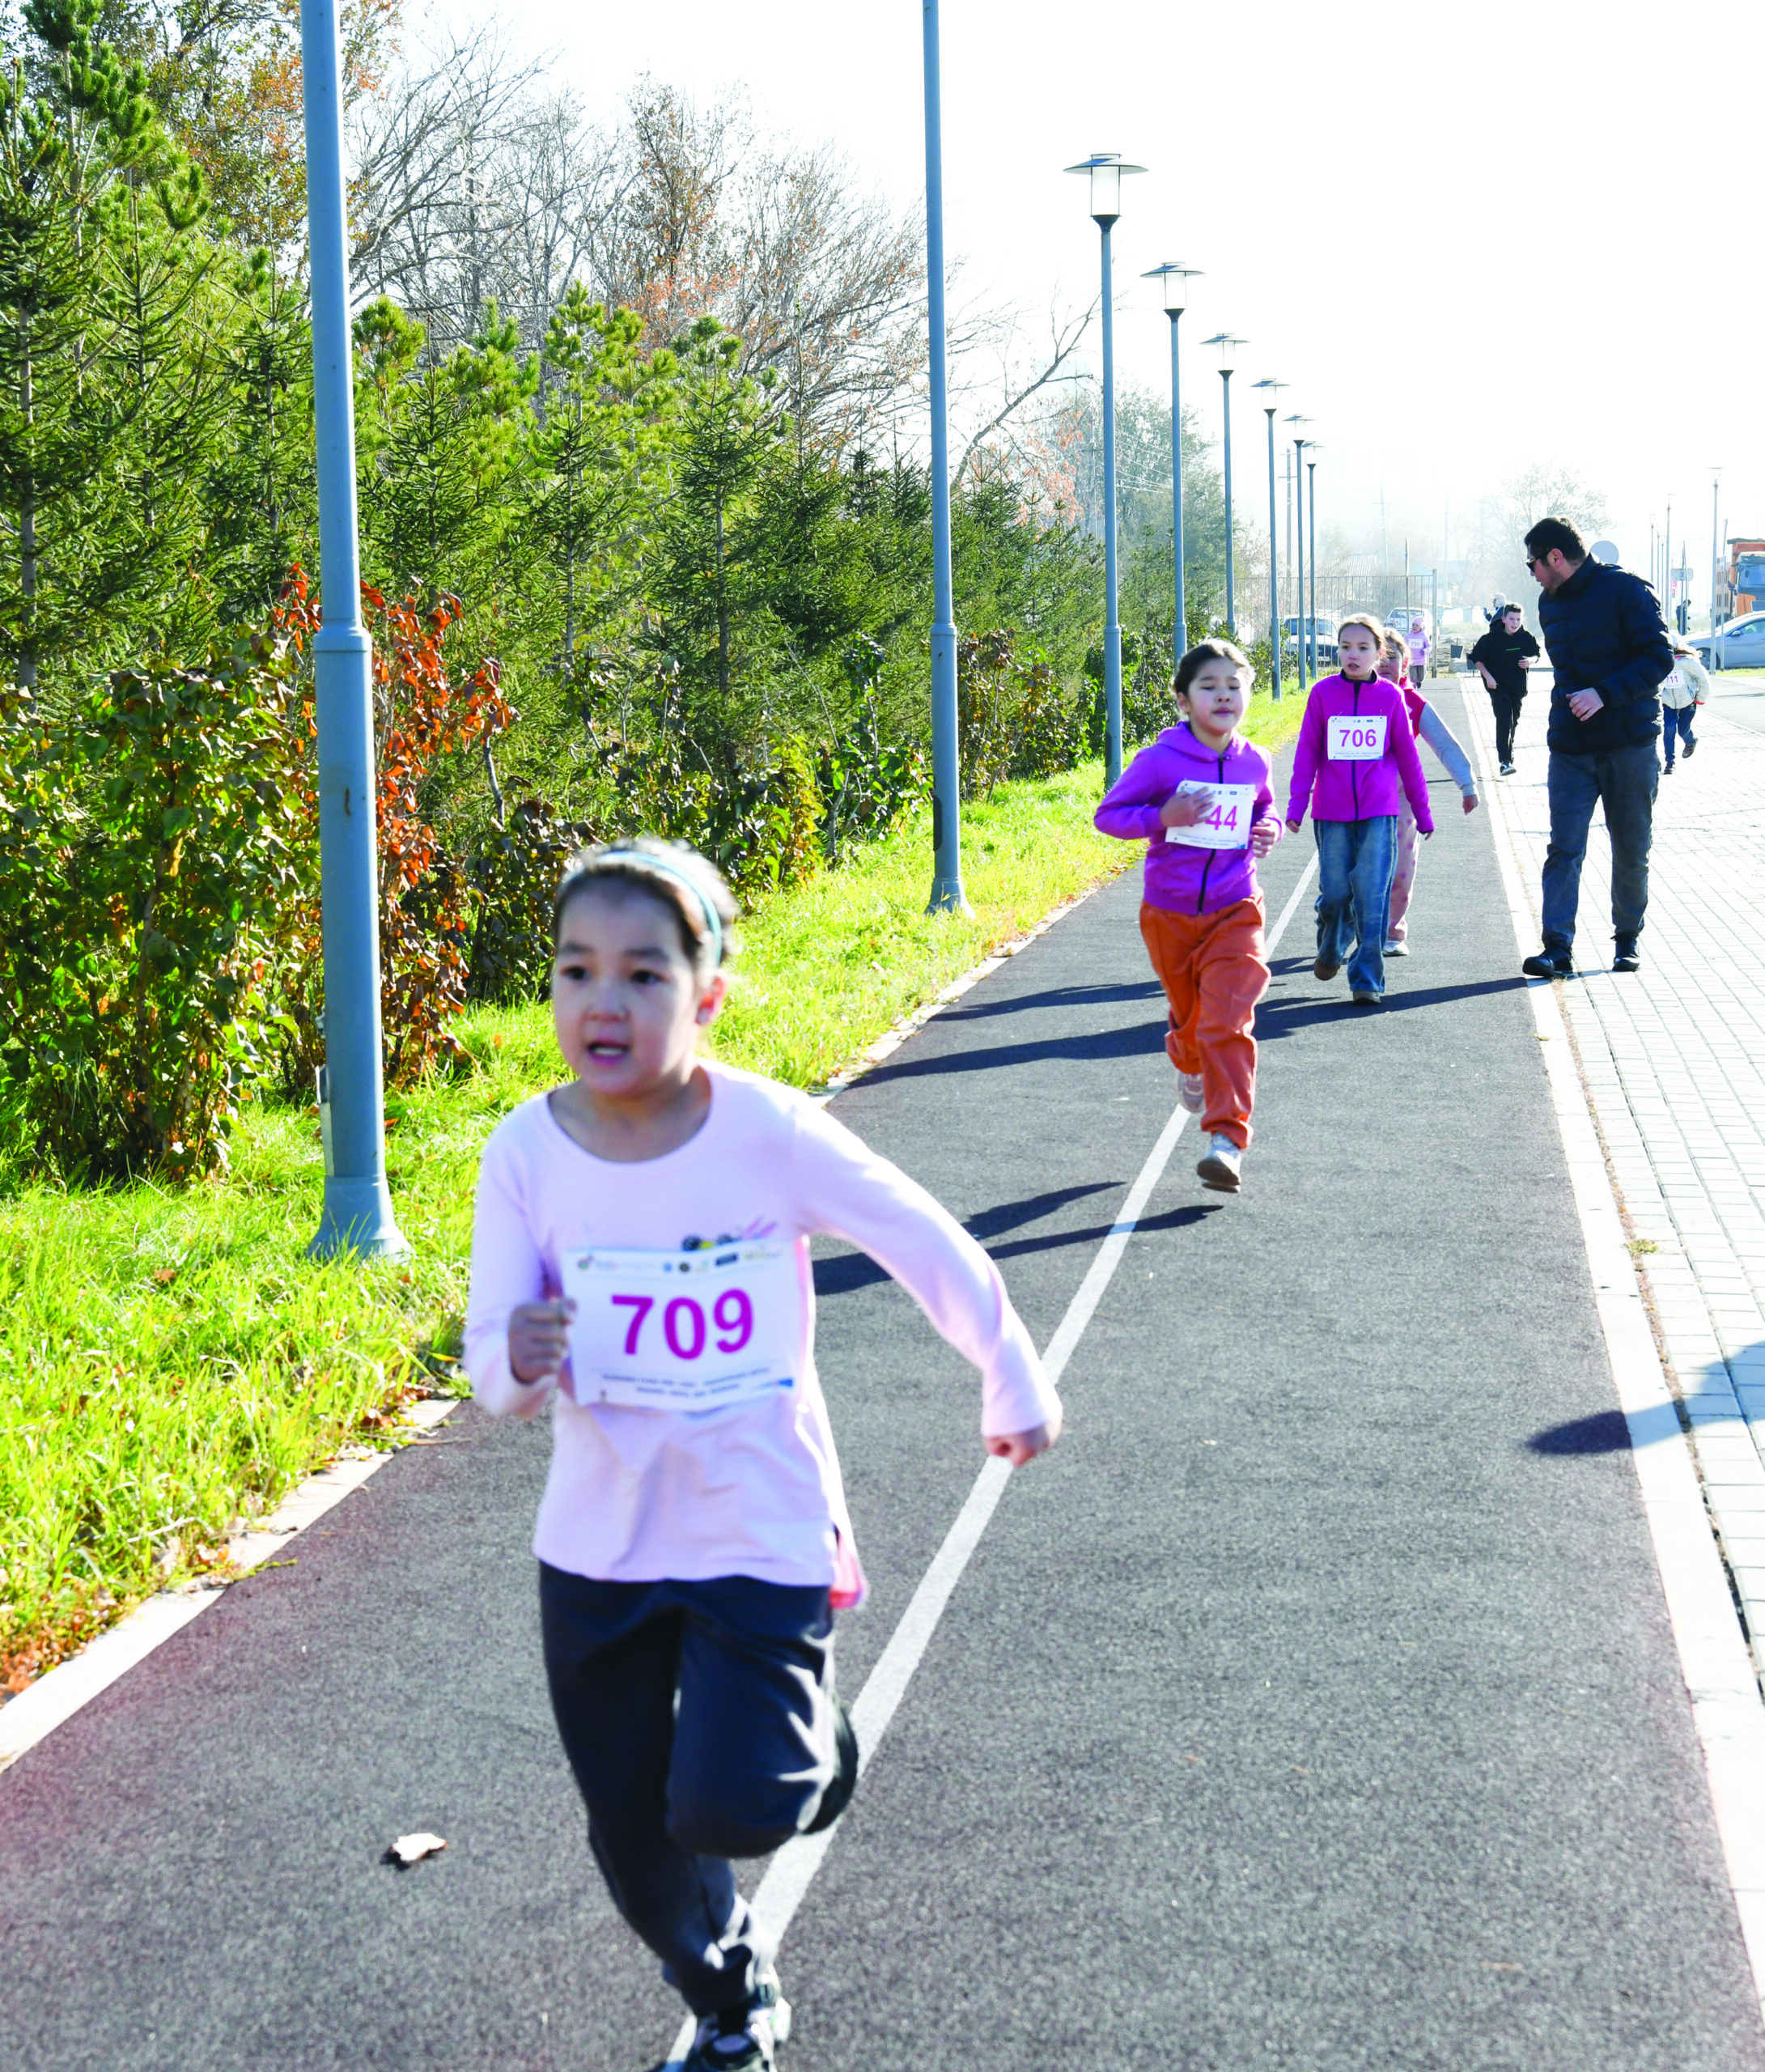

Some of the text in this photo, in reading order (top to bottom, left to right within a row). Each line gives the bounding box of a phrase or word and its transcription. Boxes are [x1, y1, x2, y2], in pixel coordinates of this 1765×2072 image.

[1339, 729, 1377, 747] 706
[1188, 805, 1237, 831] 44
[612, 1288, 753, 1360] 709
